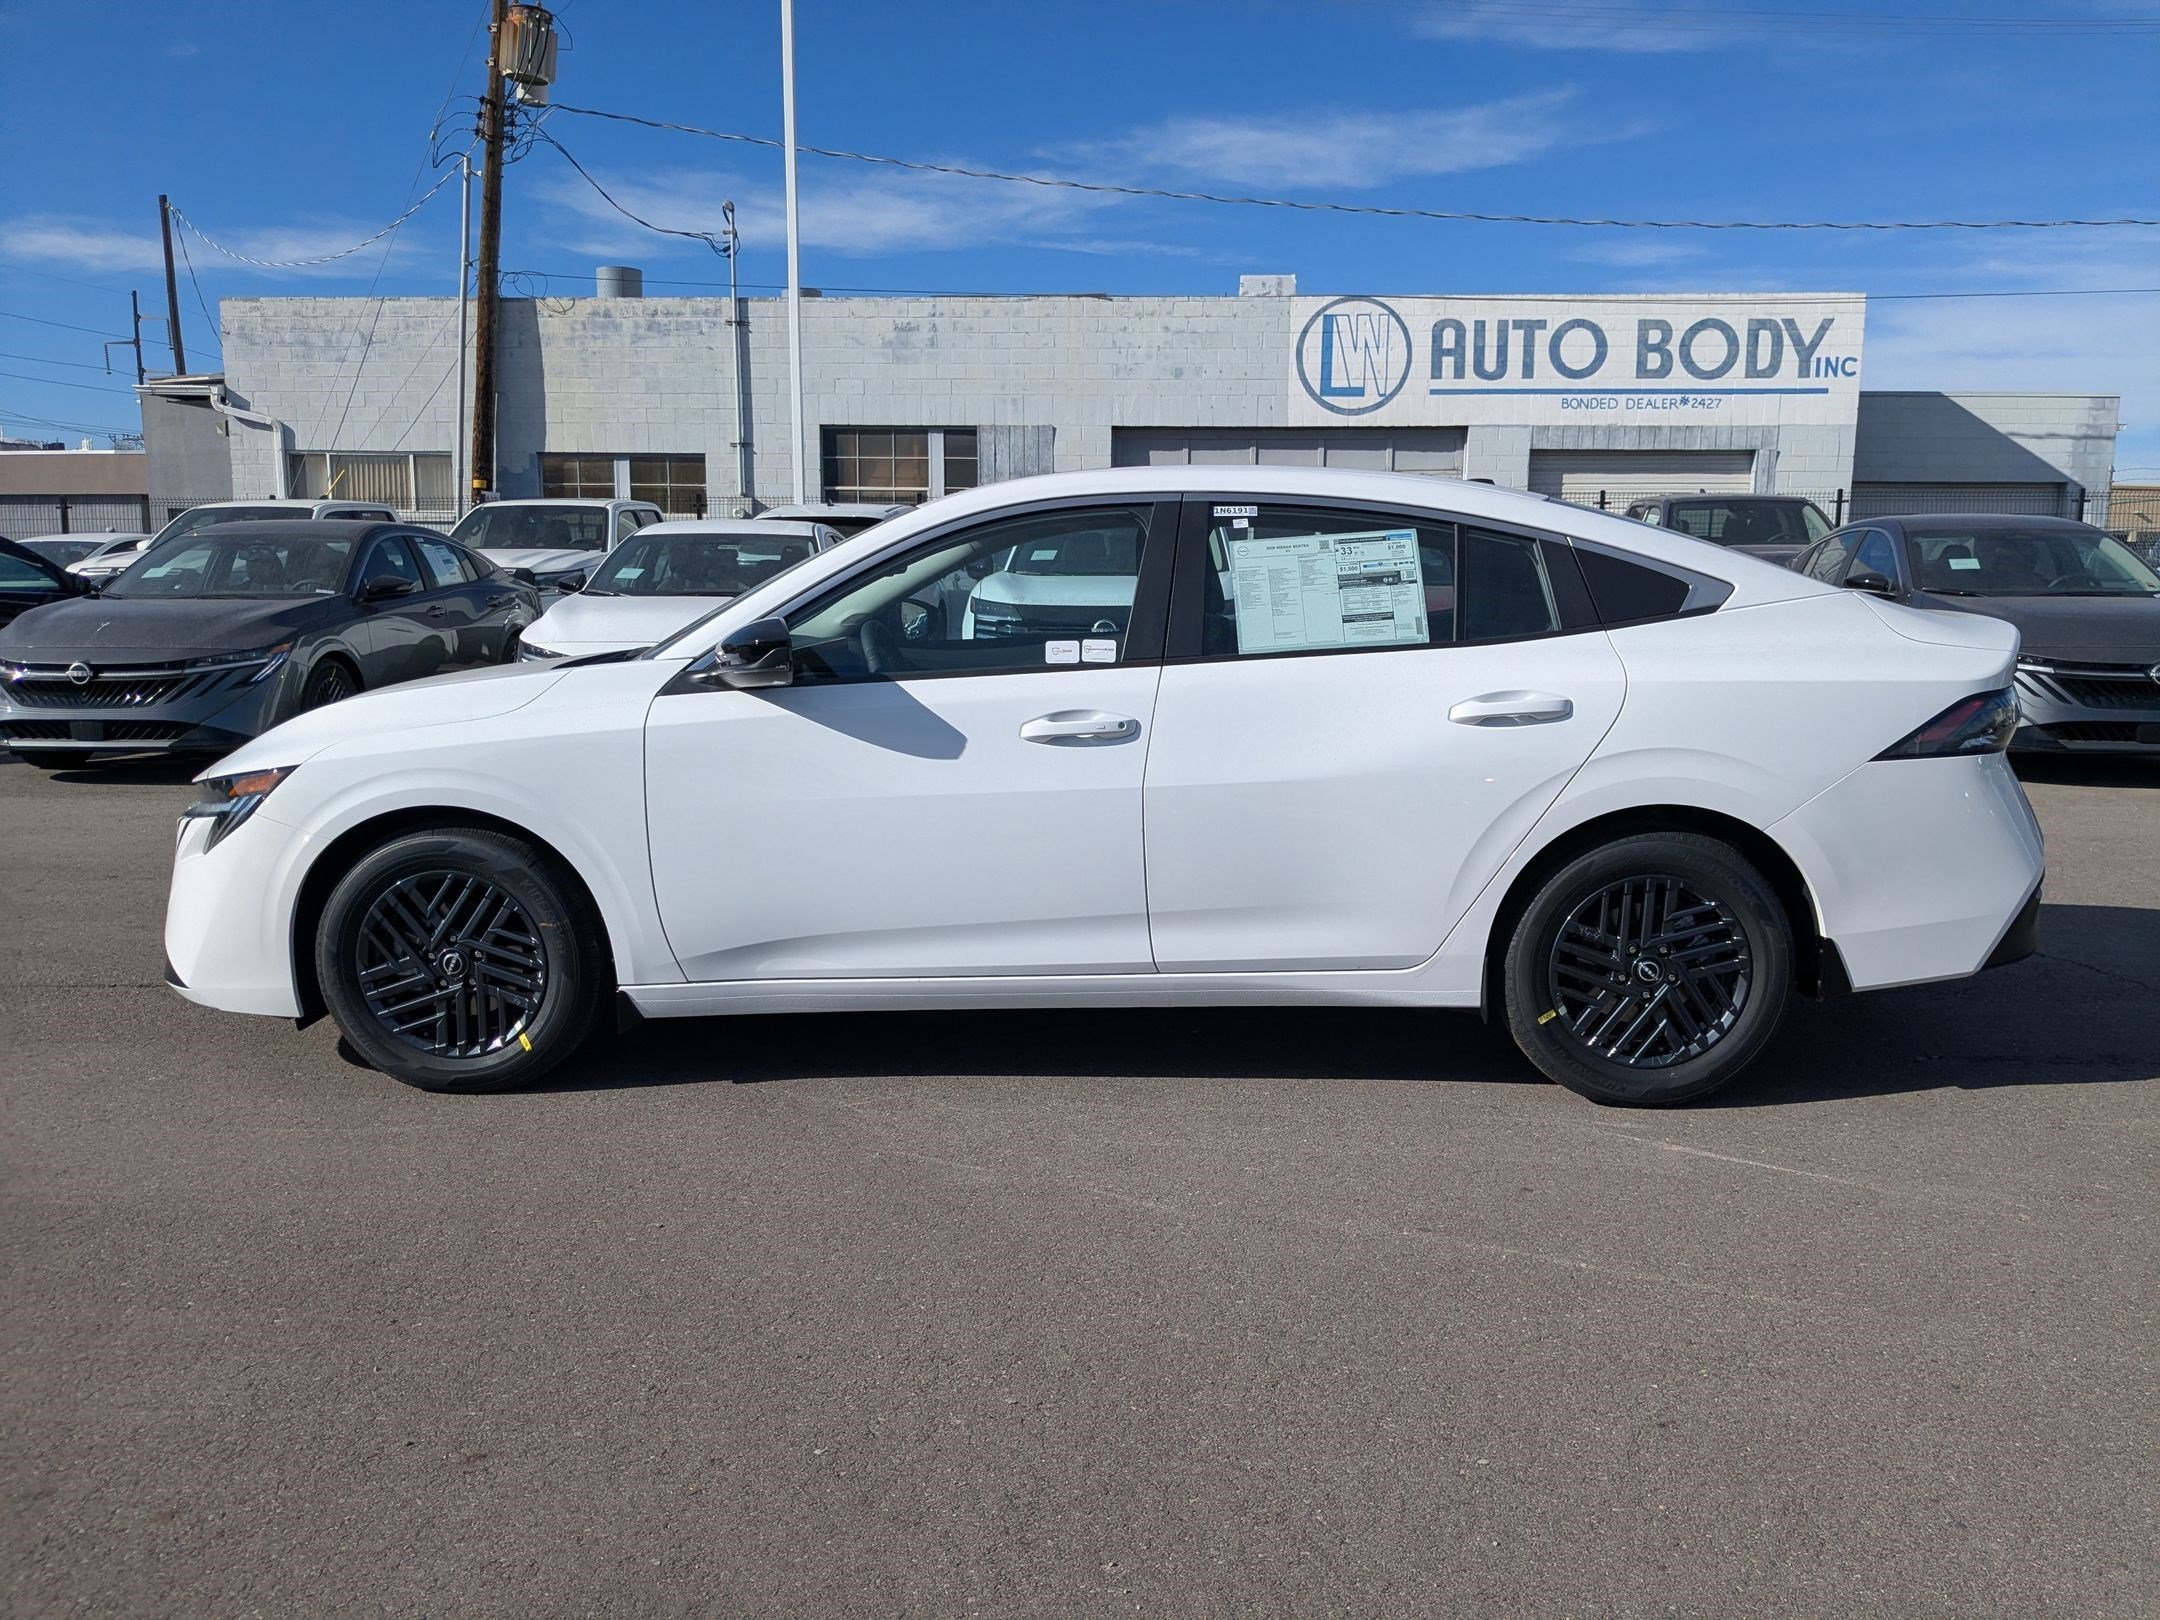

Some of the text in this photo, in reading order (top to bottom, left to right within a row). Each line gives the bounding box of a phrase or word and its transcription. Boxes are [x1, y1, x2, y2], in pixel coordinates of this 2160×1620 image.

[1431, 318, 1608, 380] AUTO
[1636, 317, 1835, 380] BODY
[1815, 357, 1858, 377] INC
[1561, 397, 1619, 410] BONDED
[1340, 546, 1353, 555] 33
